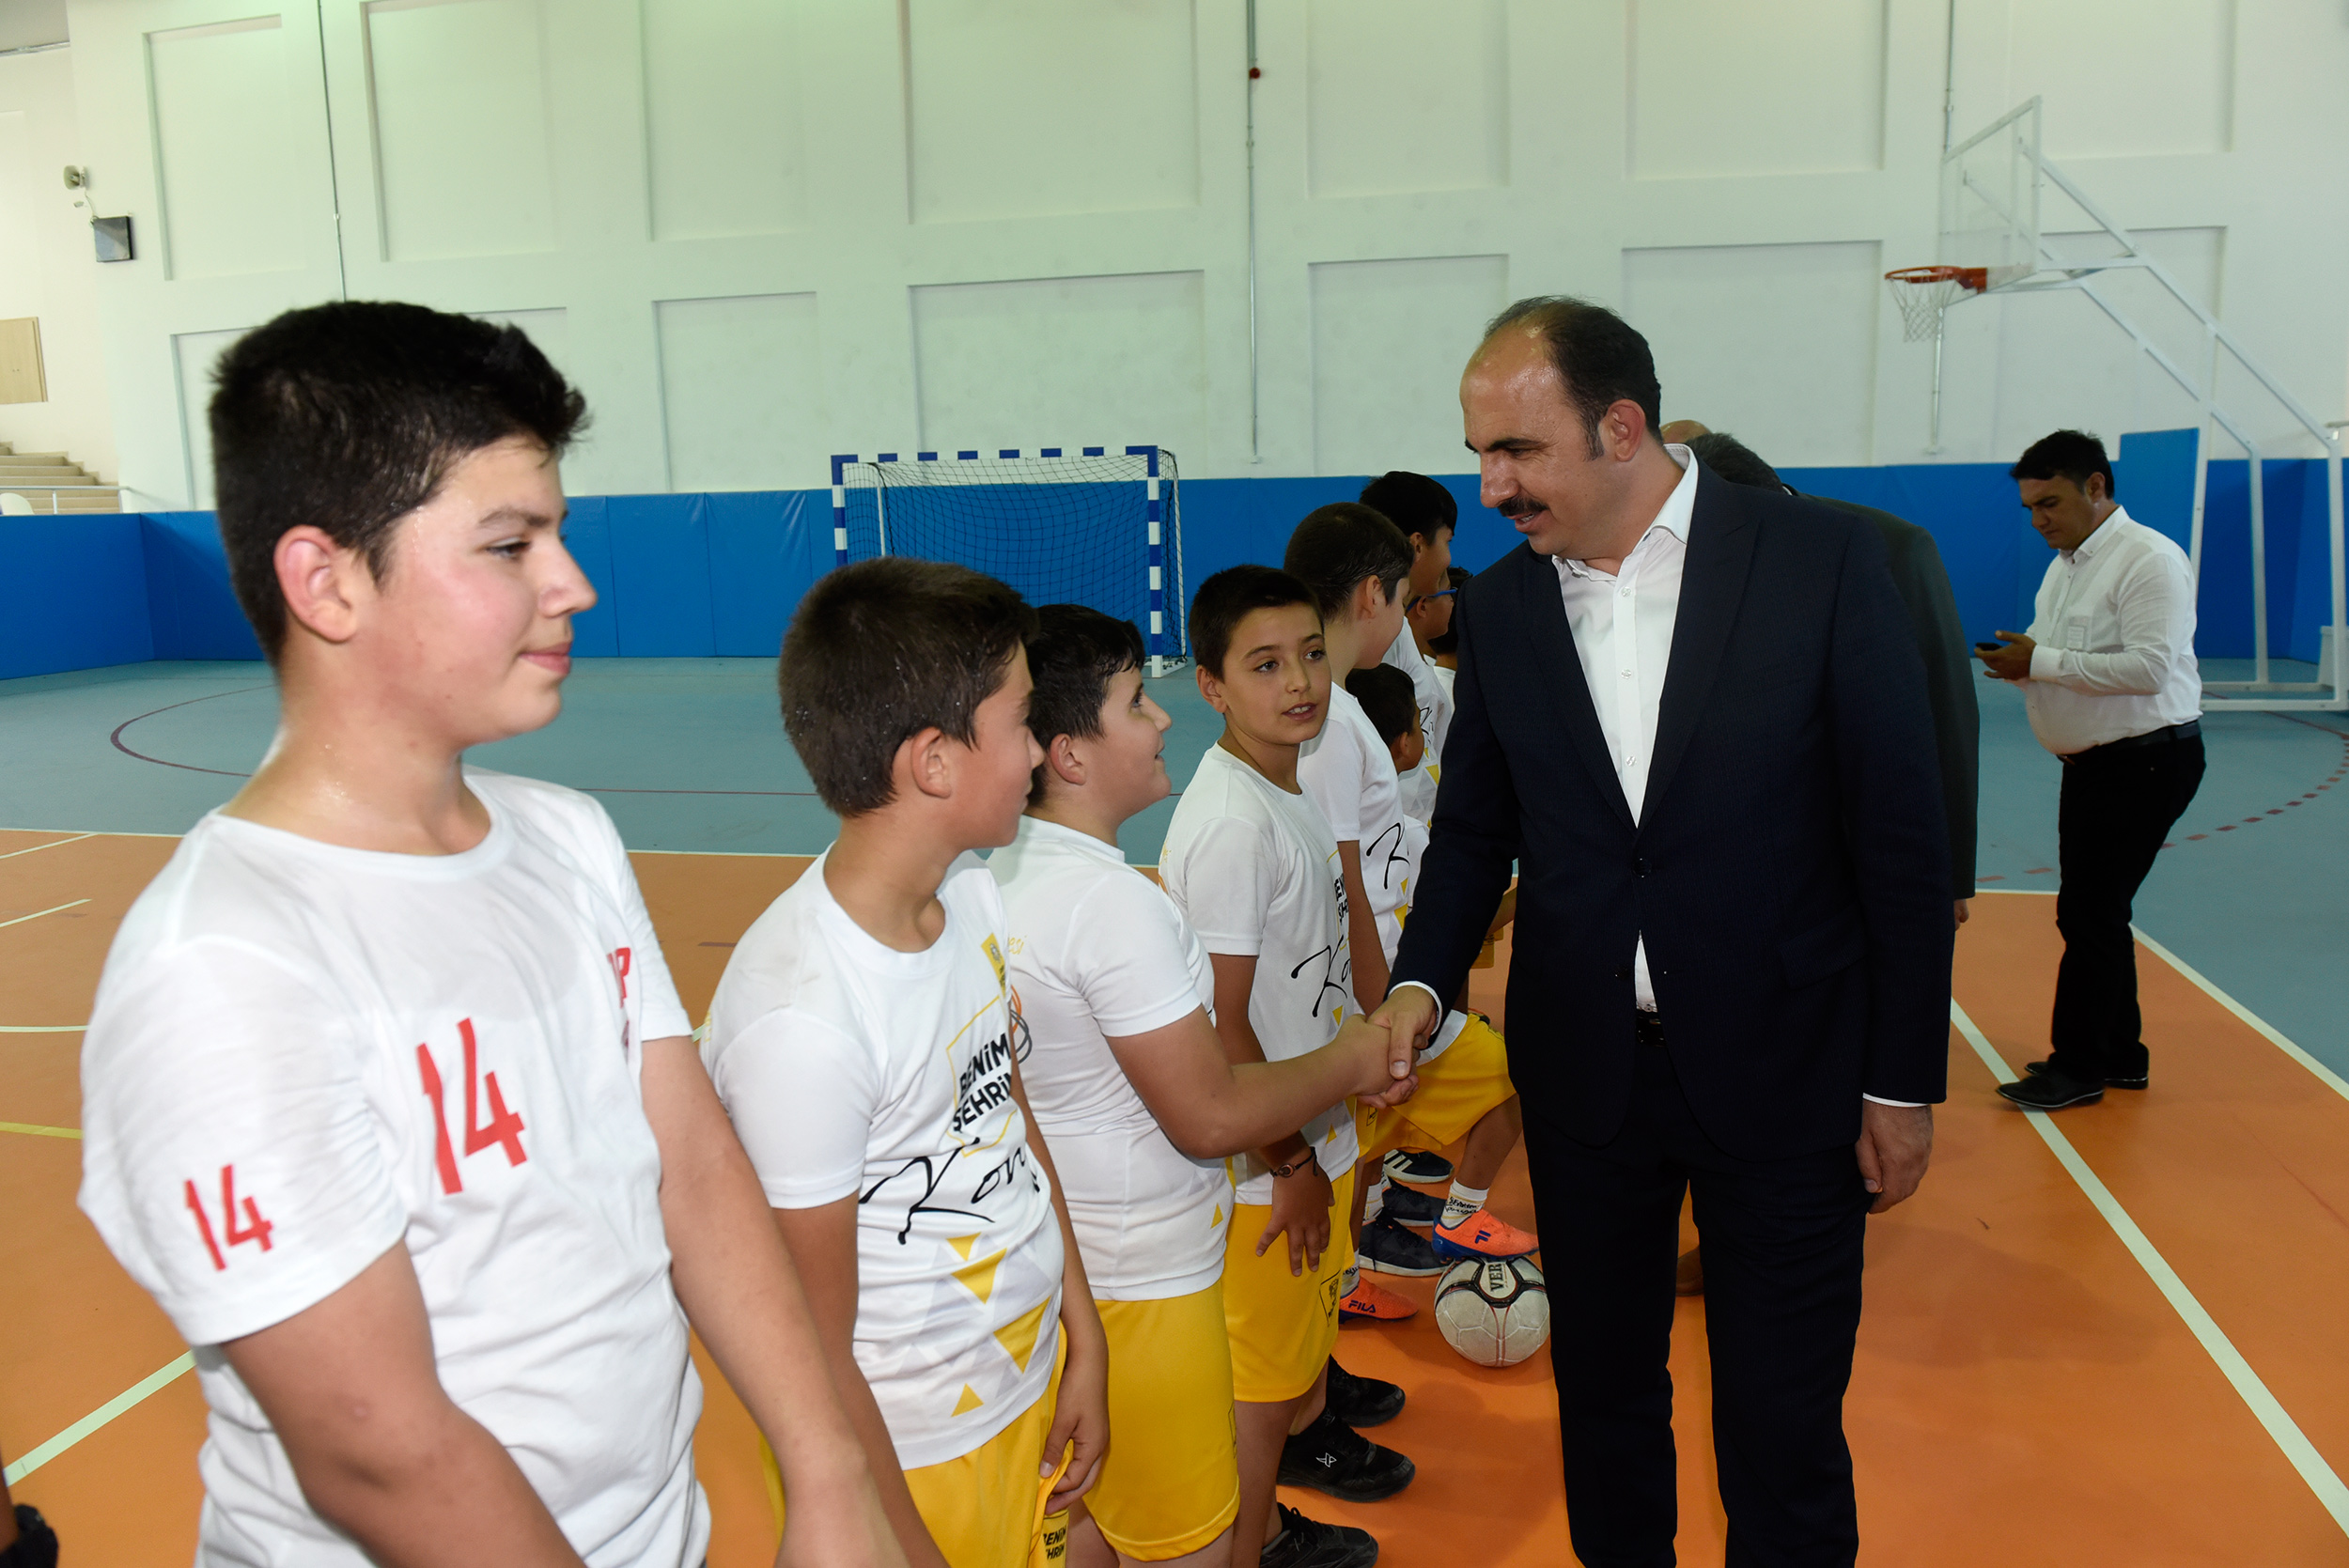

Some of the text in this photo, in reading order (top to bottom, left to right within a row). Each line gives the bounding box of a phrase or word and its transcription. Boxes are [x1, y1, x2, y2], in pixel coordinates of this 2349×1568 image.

[415, 1017, 528, 1195] 14
[184, 1164, 273, 1271] 14
[1348, 1299, 1376, 1313] FILA
